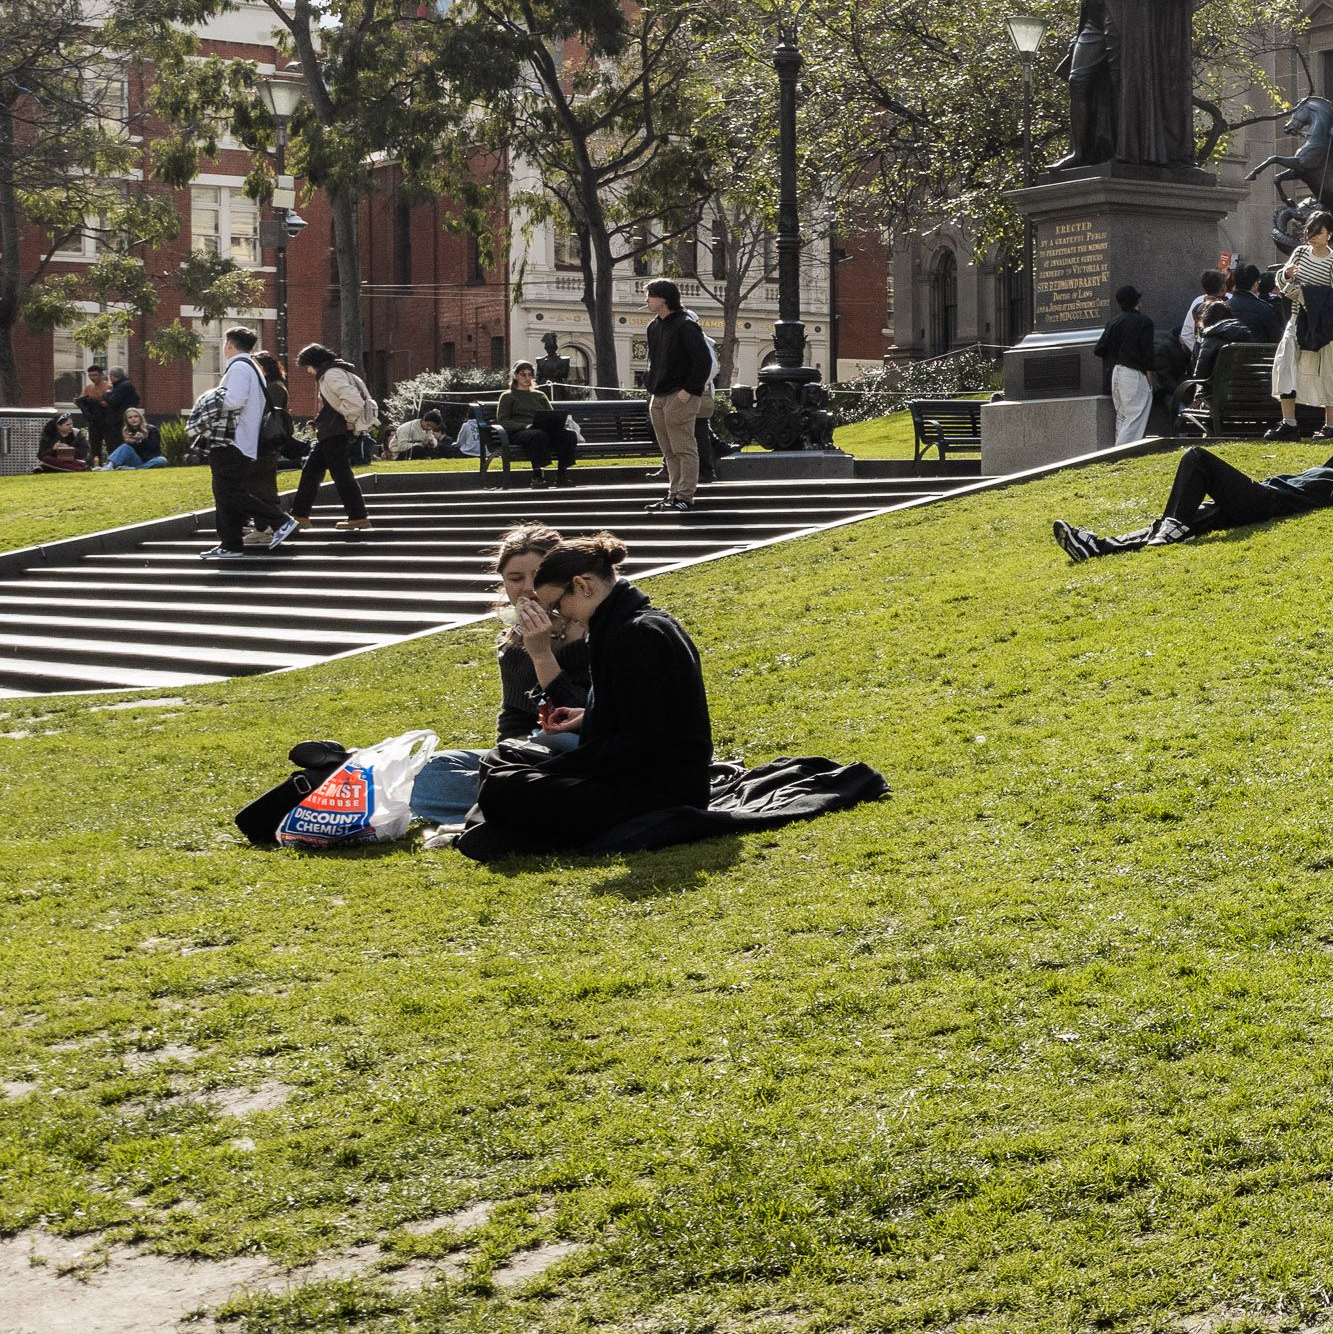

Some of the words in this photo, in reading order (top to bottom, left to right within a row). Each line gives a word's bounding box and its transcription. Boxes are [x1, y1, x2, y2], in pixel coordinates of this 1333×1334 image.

[1055, 221, 1092, 235] ERECTED
[294, 807, 361, 824] DISCOUNT
[296, 821, 352, 835] CHEMIST
